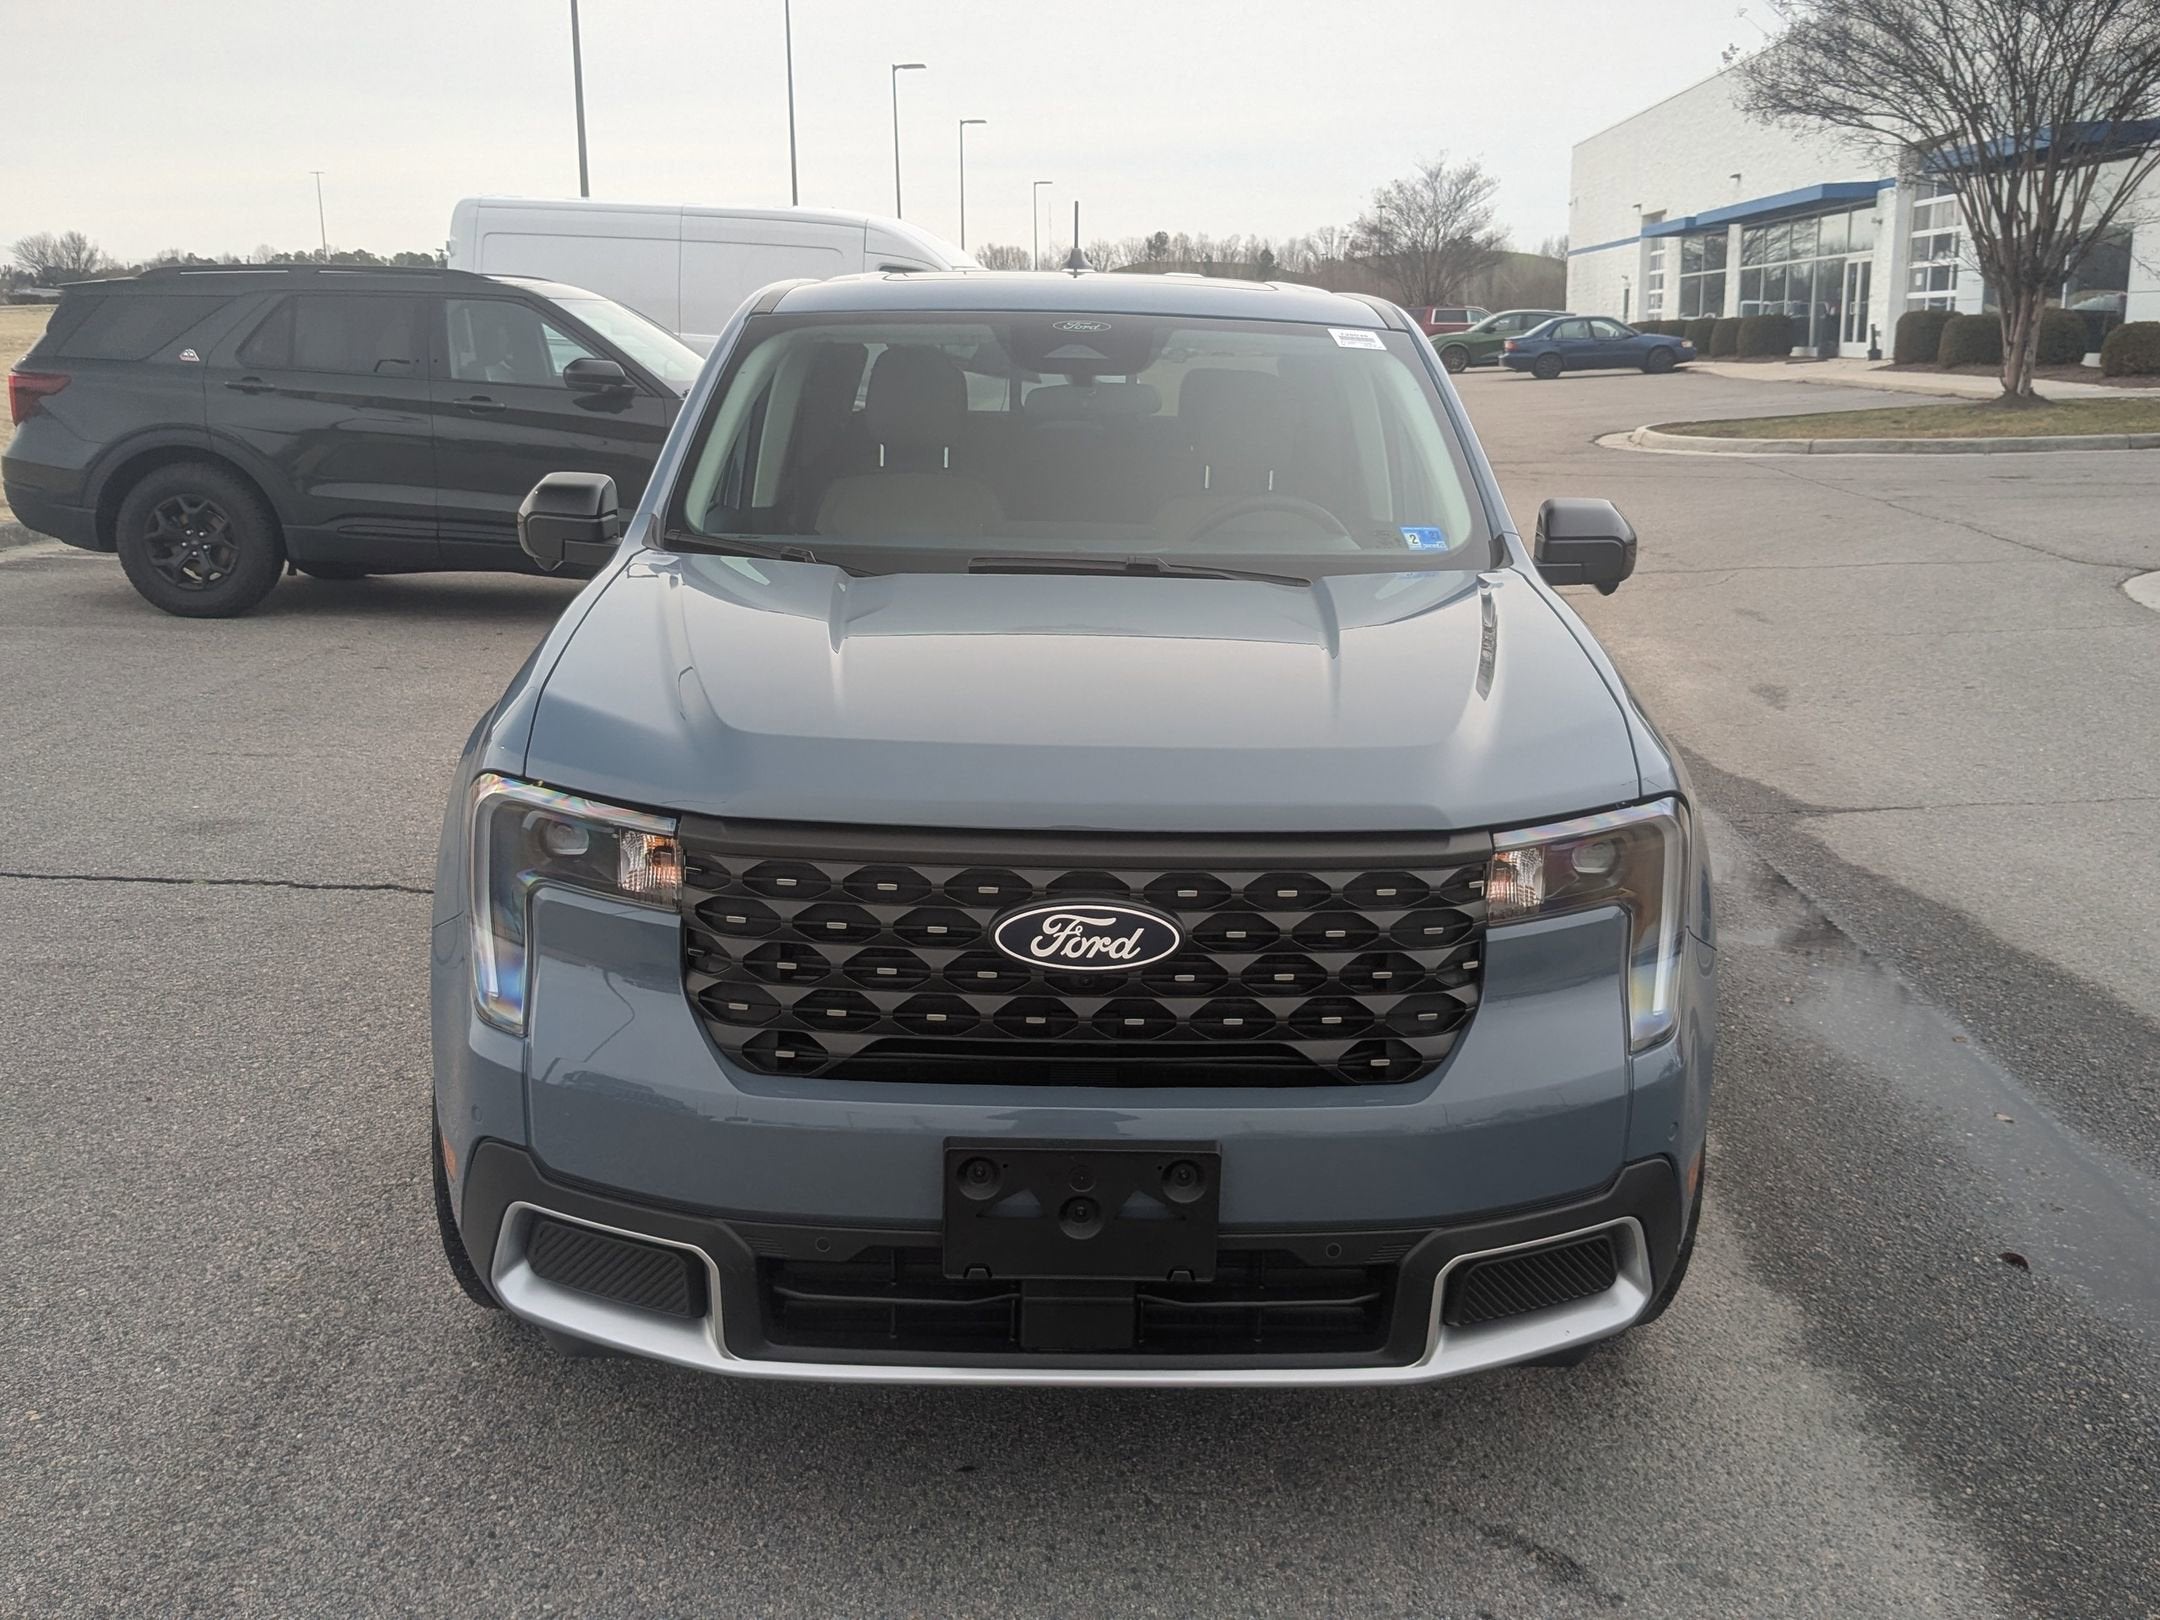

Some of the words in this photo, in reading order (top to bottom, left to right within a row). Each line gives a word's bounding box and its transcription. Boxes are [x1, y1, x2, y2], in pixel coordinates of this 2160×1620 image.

[1063, 320, 1101, 330] Ford
[1409, 534, 1419, 544] 2
[1030, 914, 1145, 960] Ford
